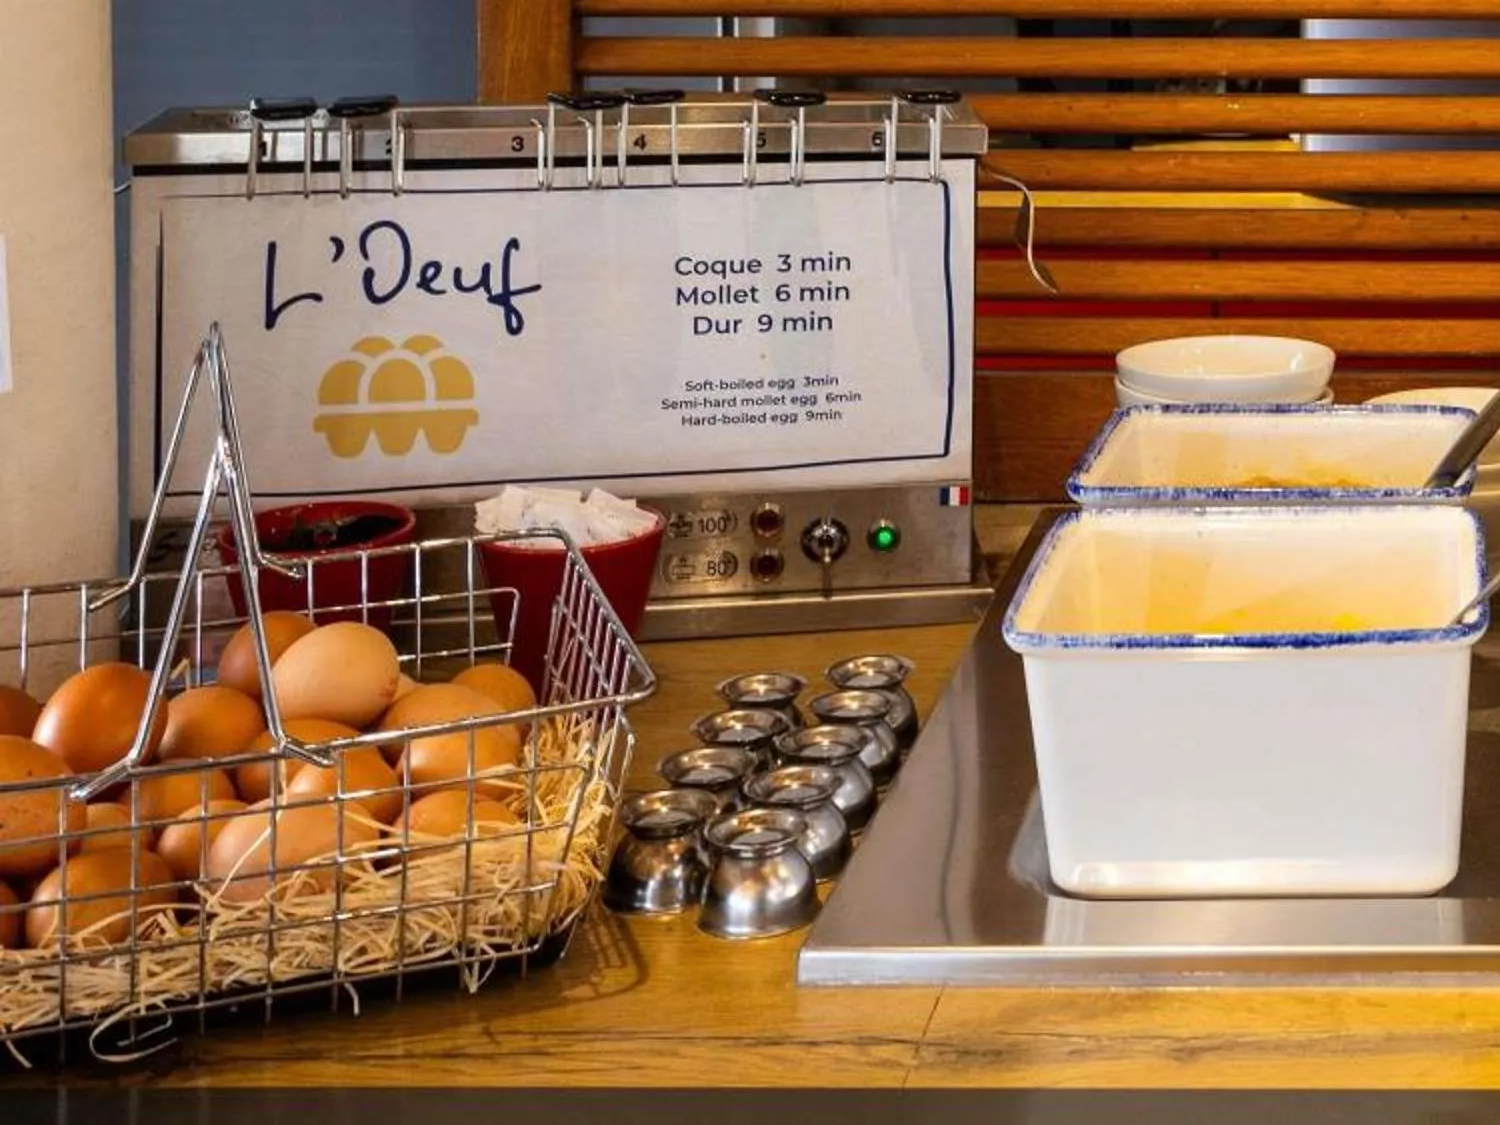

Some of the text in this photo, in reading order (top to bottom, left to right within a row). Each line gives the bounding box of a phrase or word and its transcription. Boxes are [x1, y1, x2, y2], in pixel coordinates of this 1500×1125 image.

[511, 136, 525, 152] 3
[633, 133, 648, 151] 4
[673, 251, 851, 280] Coque 3 min
[675, 280, 850, 306] Mollet 6 min
[693, 310, 834, 336] Dur 9 min
[685, 374, 840, 393] Soft-boiled egg 3min
[660, 390, 863, 410] Semi-hard mollet egg 6min
[680, 408, 843, 427] Hard-boiled egg 9min
